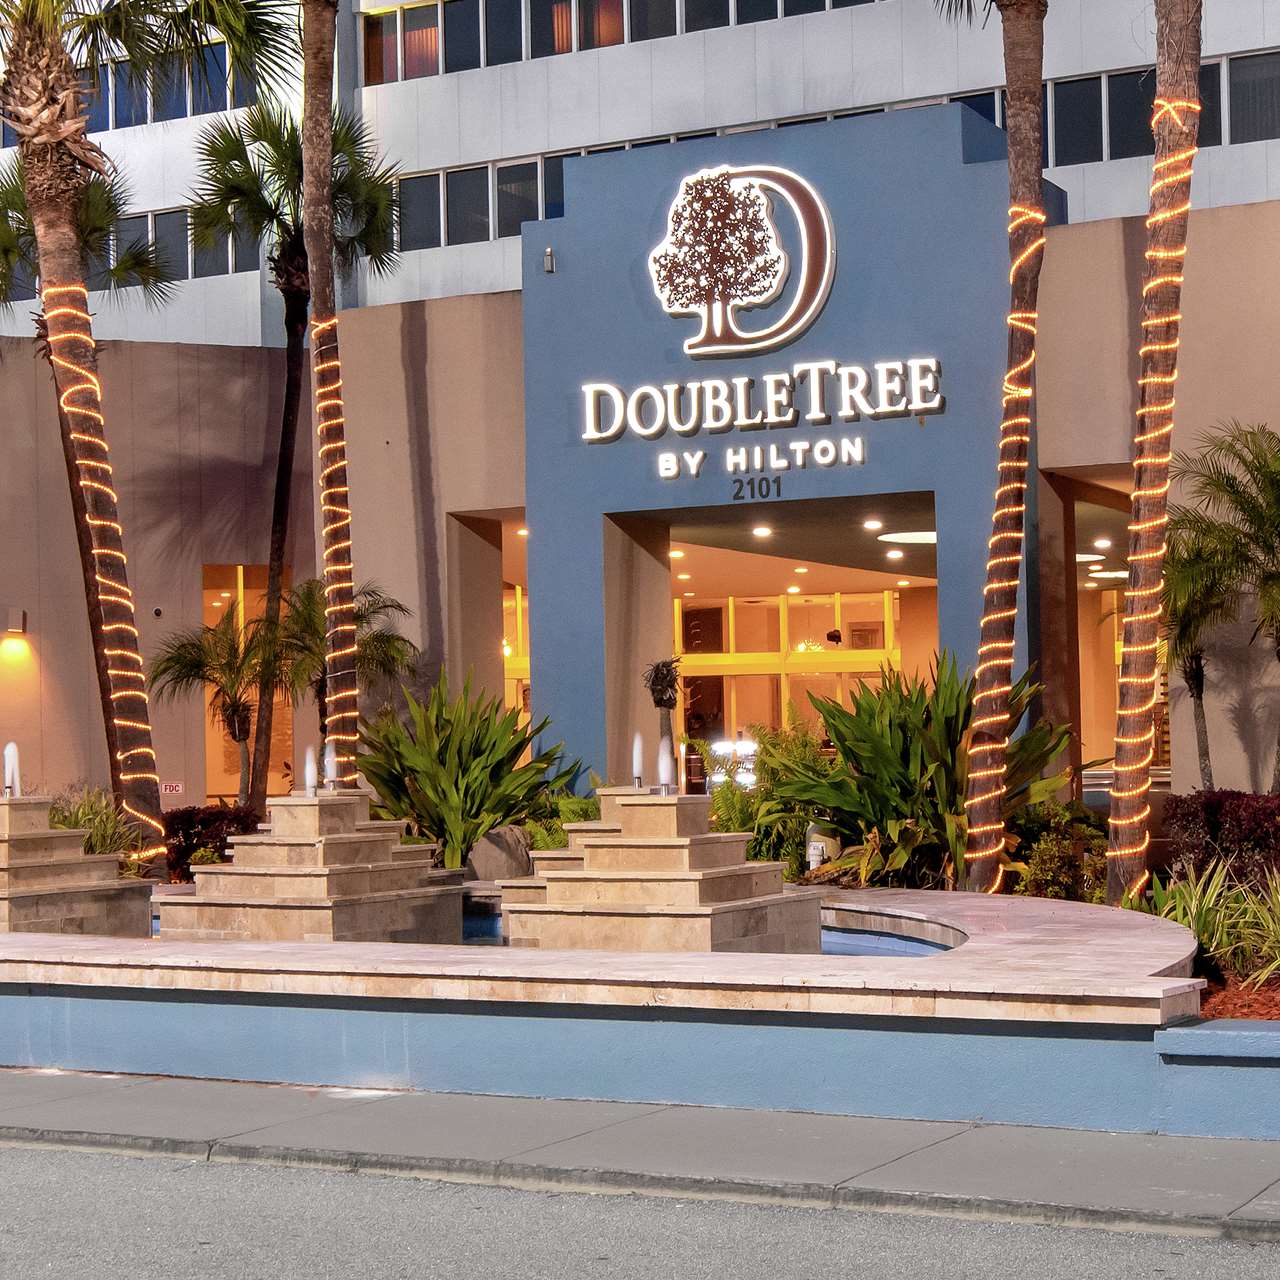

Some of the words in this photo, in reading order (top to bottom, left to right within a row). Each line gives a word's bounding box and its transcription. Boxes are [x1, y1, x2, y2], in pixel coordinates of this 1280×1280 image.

[581, 358, 945, 442] DOUBLETREE
[658, 450, 706, 479] BY
[726, 437, 866, 473] HILTON
[732, 476, 783, 501] 2101
[164, 784, 180, 793] FDC
